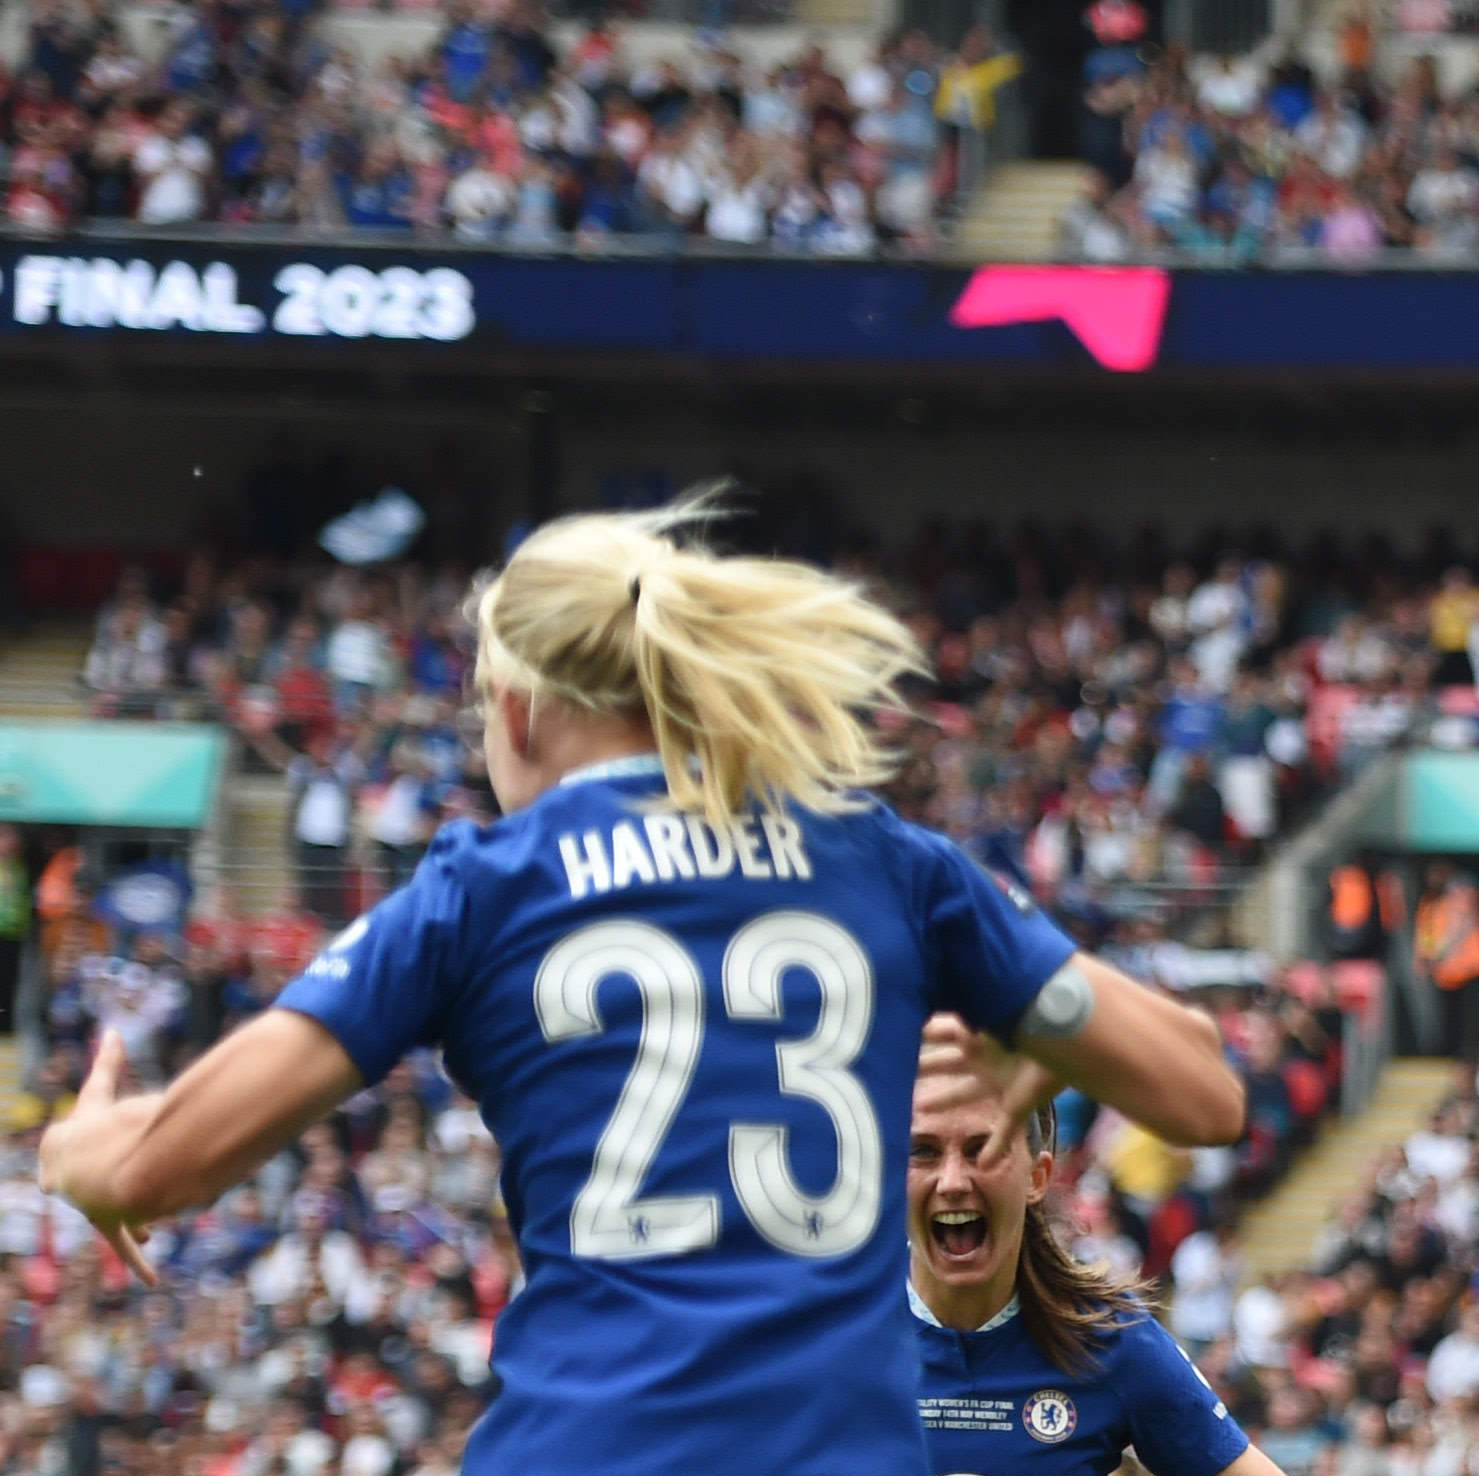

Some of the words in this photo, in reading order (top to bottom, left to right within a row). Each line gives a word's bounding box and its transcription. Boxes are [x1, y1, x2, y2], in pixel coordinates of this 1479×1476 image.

[13, 255, 267, 333] FINAL
[273, 262, 476, 341] 2023
[558, 811, 811, 897] HARDER
[533, 909, 881, 1260] 23
